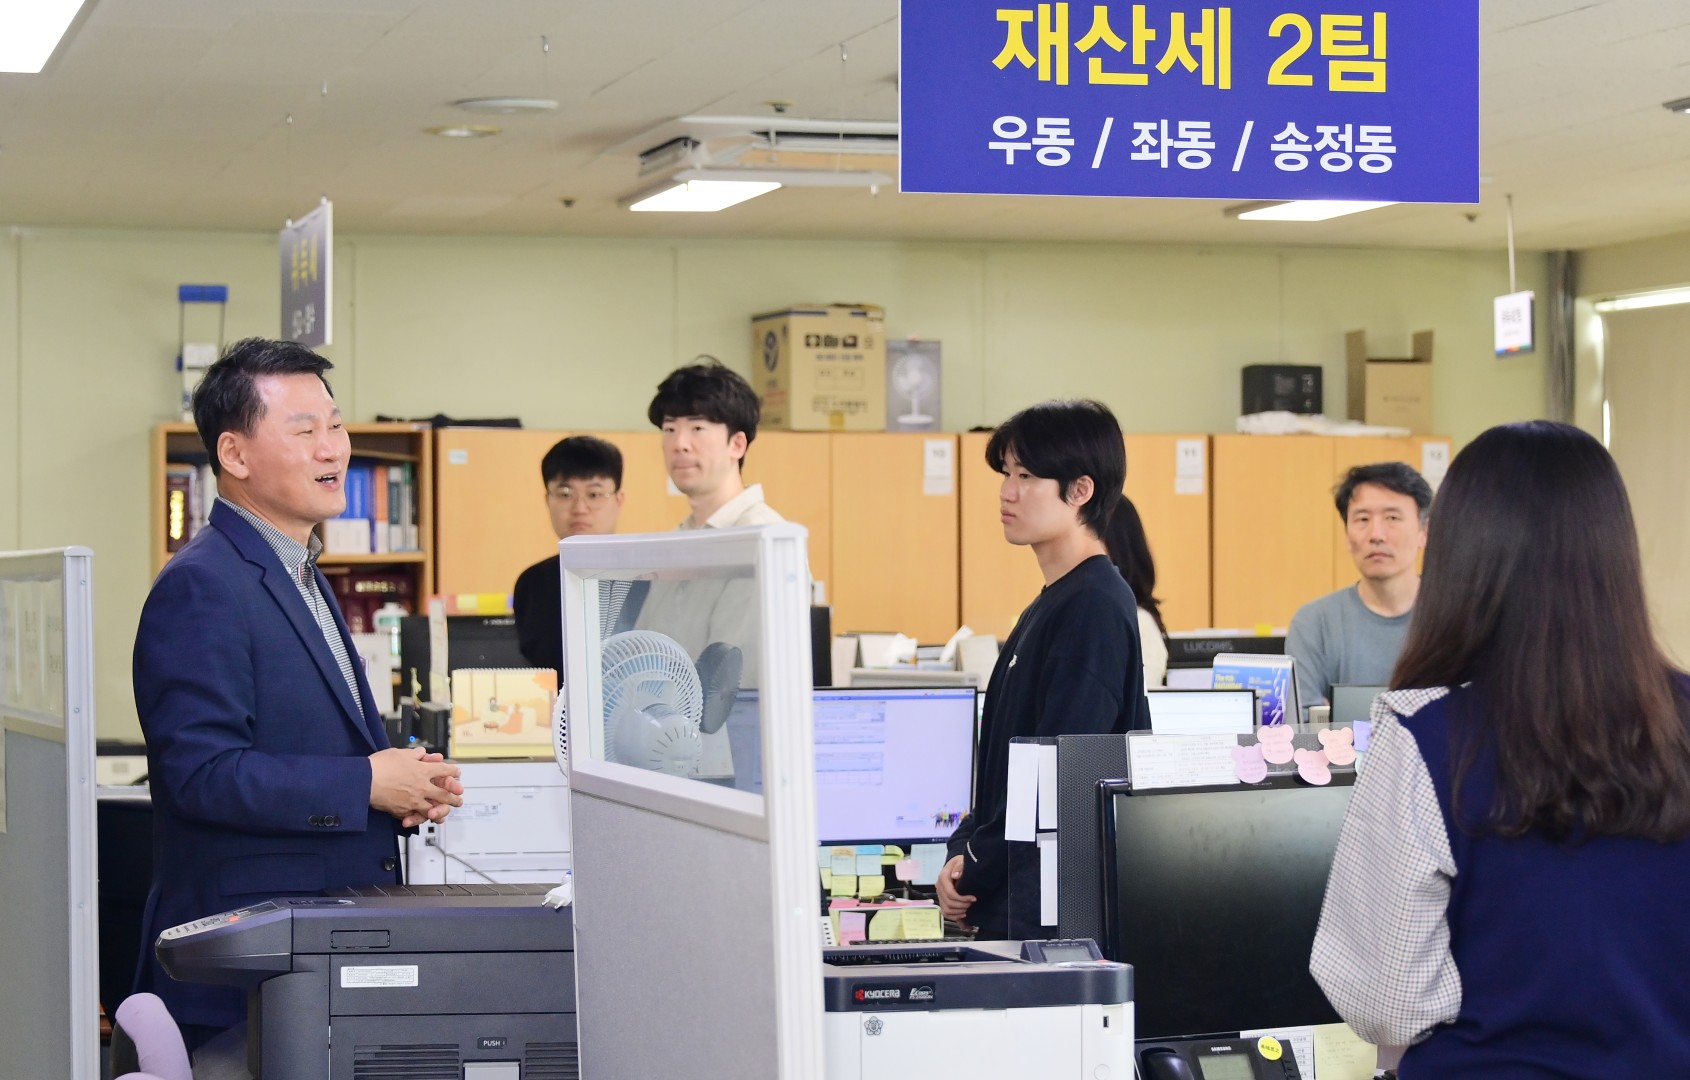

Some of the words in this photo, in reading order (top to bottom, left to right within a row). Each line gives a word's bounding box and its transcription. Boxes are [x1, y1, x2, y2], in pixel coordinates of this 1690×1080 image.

[992, 3, 1231, 89] 재산세
[1268, 12, 1387, 92] 2팀
[989, 116, 1075, 166] 우동
[1092, 117, 1114, 169] /
[1131, 119, 1215, 170] 좌동
[1232, 121, 1254, 172] /
[1270, 122, 1397, 173] 송정동
[864, 989, 901, 999] KYOCERA
